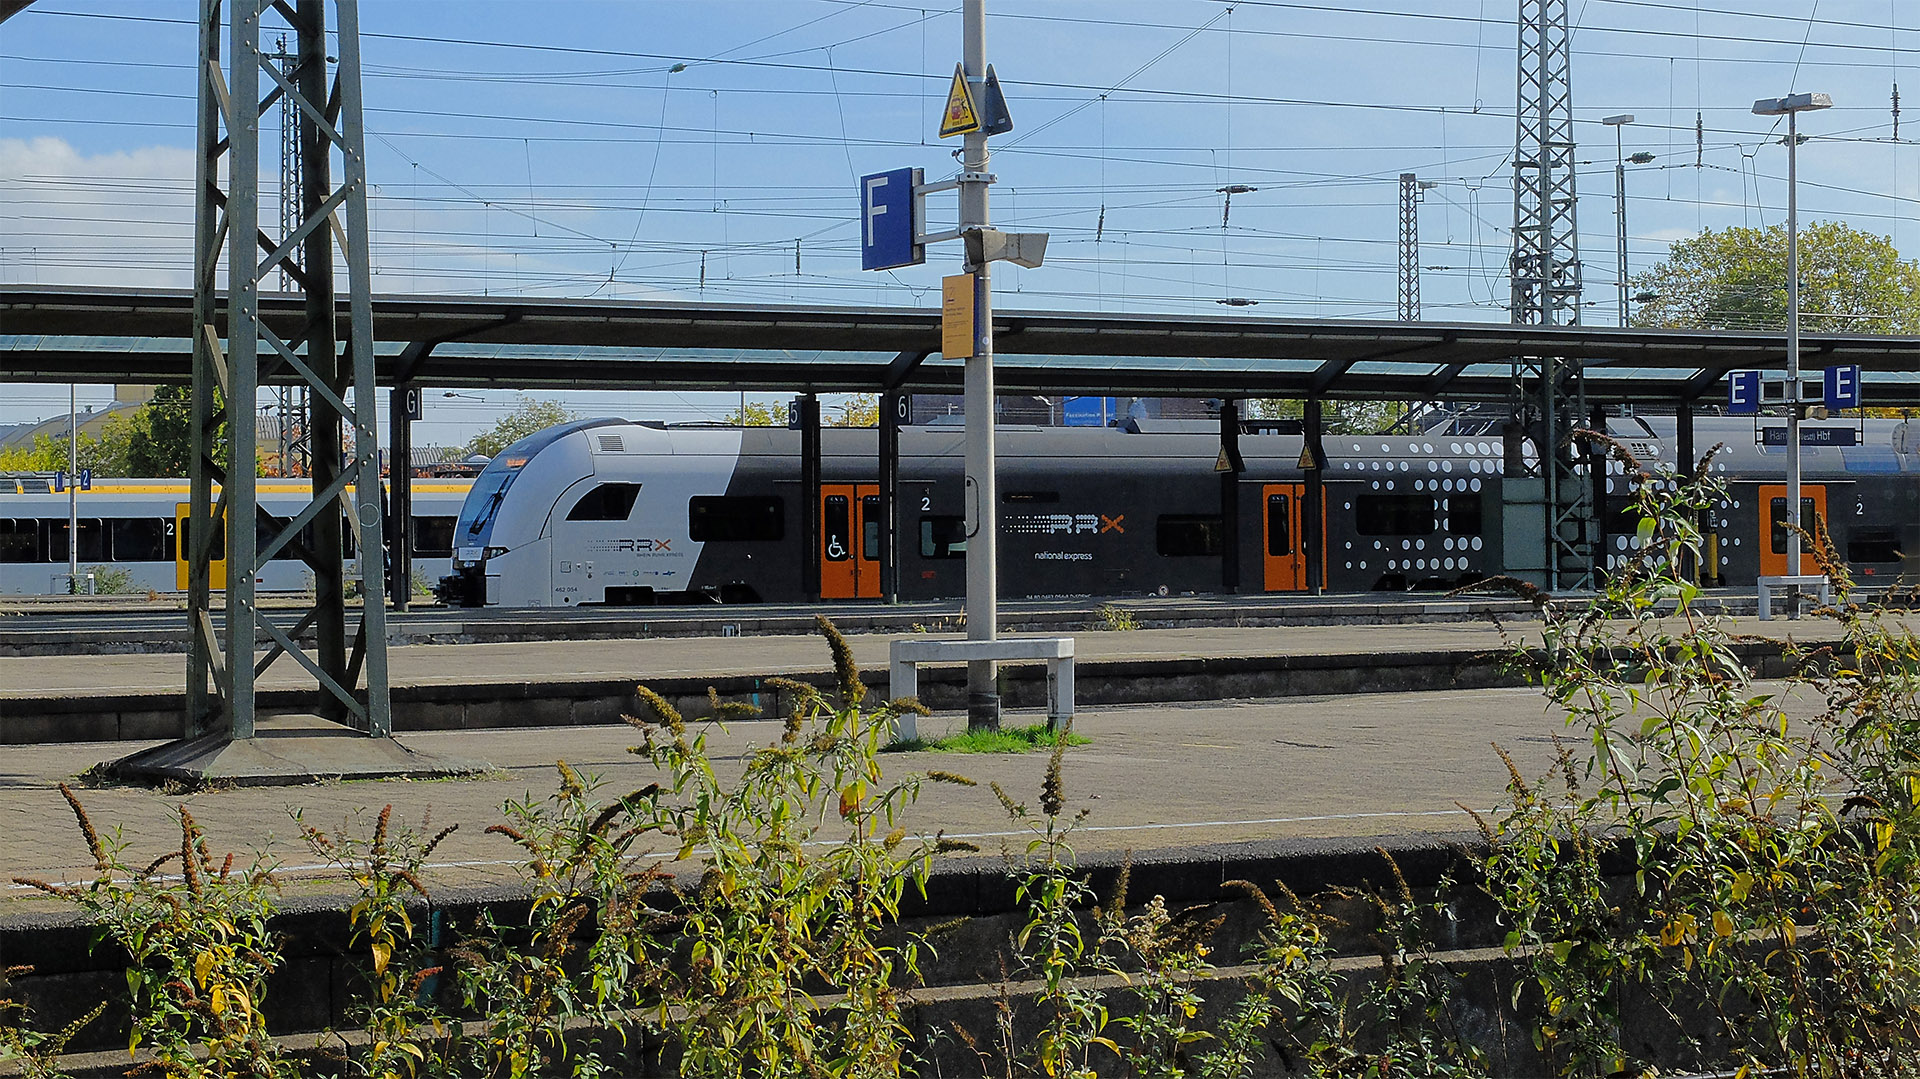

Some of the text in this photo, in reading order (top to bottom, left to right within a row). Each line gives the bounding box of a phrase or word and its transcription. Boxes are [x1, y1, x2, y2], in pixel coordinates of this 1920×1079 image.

[867, 177, 888, 247] F
[1732, 373, 1746, 404] E
[1836, 367, 1851, 399] E
[406, 389, 416, 414] G
[897, 395, 907, 418] 6
[790, 402, 798, 424] 5
[1769, 430, 1788, 440] Ham
[1816, 430, 1831, 441] Hbf
[55, 472, 59, 488] 1
[83, 469, 88, 486] 2
[921, 496, 931, 511] 2
[1856, 502, 1864, 515] 2
[166, 522, 174, 536] 2
[1050, 514, 1125, 534] RRX
[619, 538, 671, 552] RRX
[1034, 550, 1093, 562] national express
